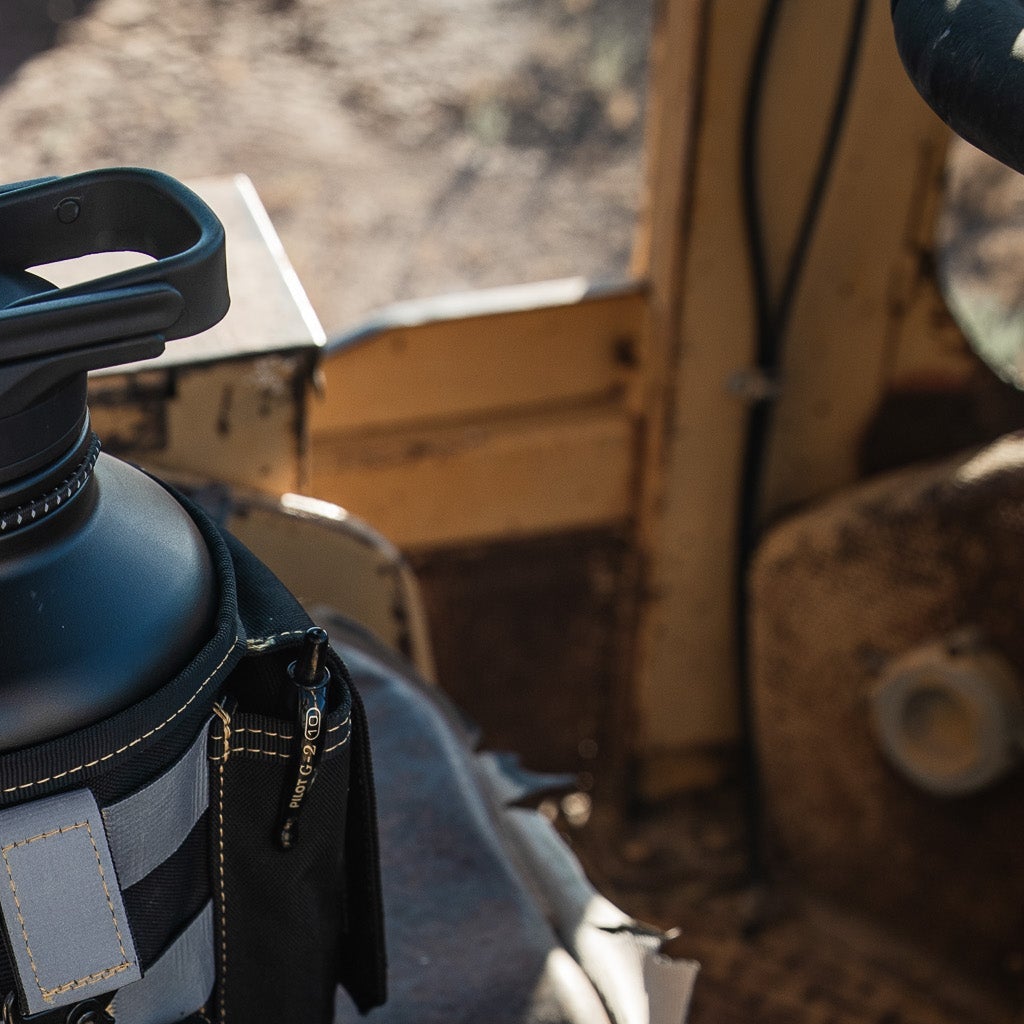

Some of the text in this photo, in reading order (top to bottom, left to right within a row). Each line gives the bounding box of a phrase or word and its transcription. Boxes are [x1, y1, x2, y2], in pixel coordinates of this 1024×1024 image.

[289, 713, 319, 809] PILOT G-2 10
